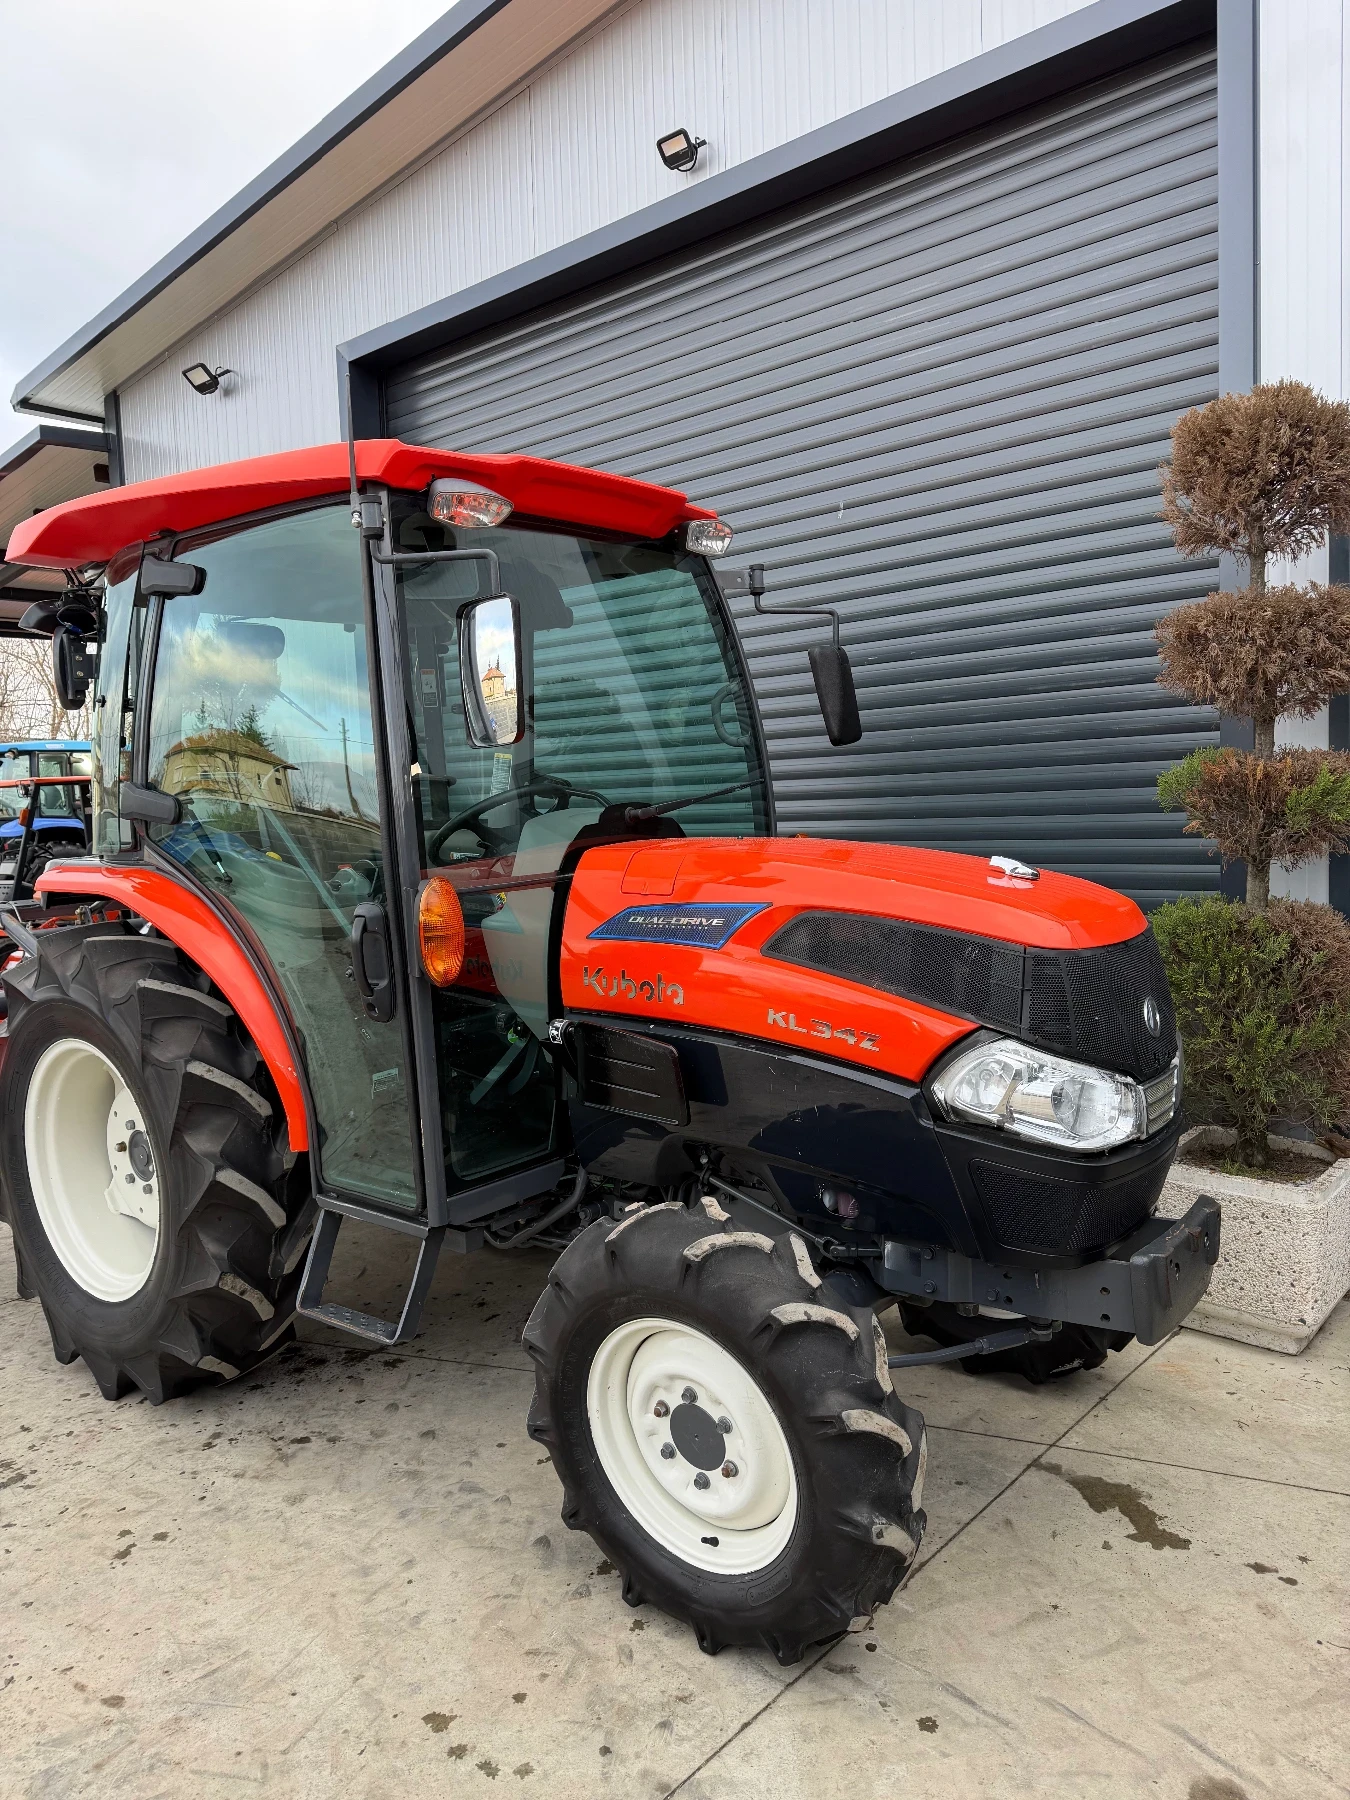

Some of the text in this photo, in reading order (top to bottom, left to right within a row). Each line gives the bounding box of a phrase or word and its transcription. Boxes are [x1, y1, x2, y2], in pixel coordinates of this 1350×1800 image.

[627, 915, 726, 926] DUAL-DRIVE
[583, 965, 685, 1006] Kubota
[767, 1007, 881, 1052] KL34Z
